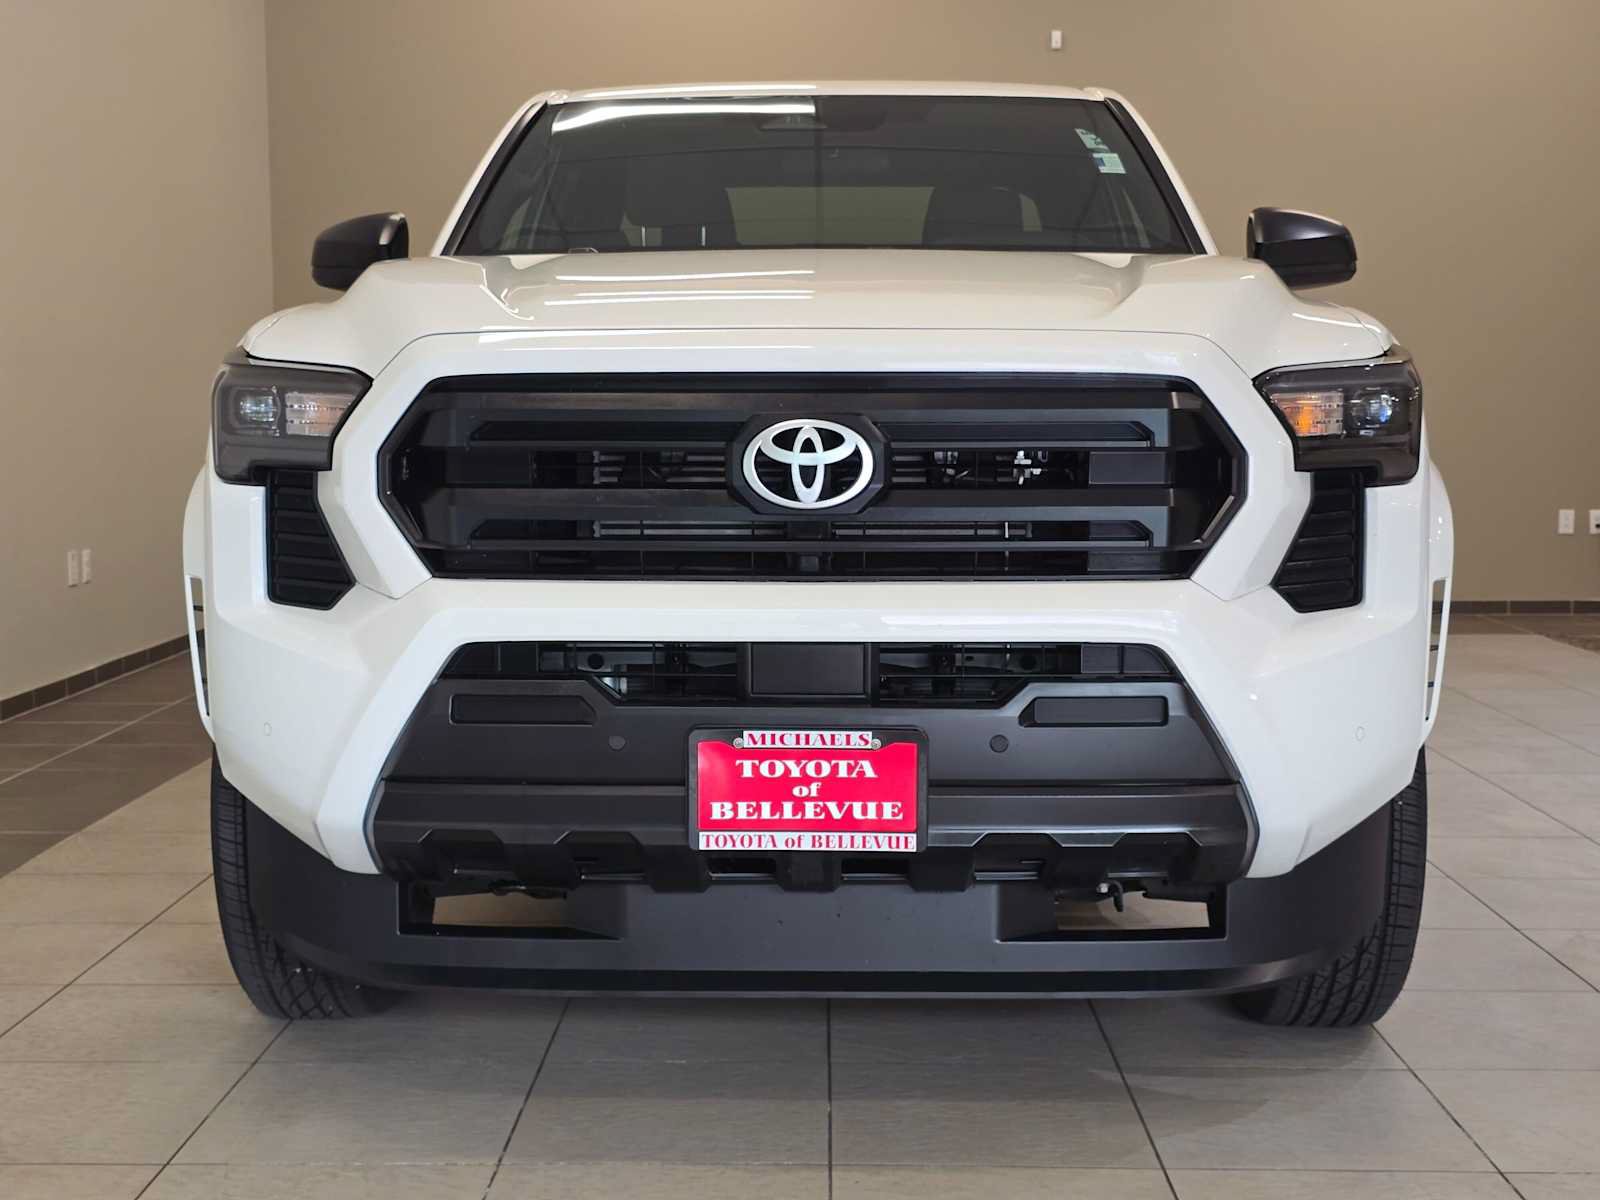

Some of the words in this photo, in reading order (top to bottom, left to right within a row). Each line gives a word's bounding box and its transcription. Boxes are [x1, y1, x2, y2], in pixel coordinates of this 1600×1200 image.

[747, 733, 871, 747] MICHAELS
[735, 759, 878, 778] TOYOTA
[792, 782, 822, 797] of
[709, 801, 904, 820] BELLEVUE
[702, 834, 778, 849] TOYOTA
[784, 834, 804, 849] of
[811, 834, 915, 850] BELLEVUE
